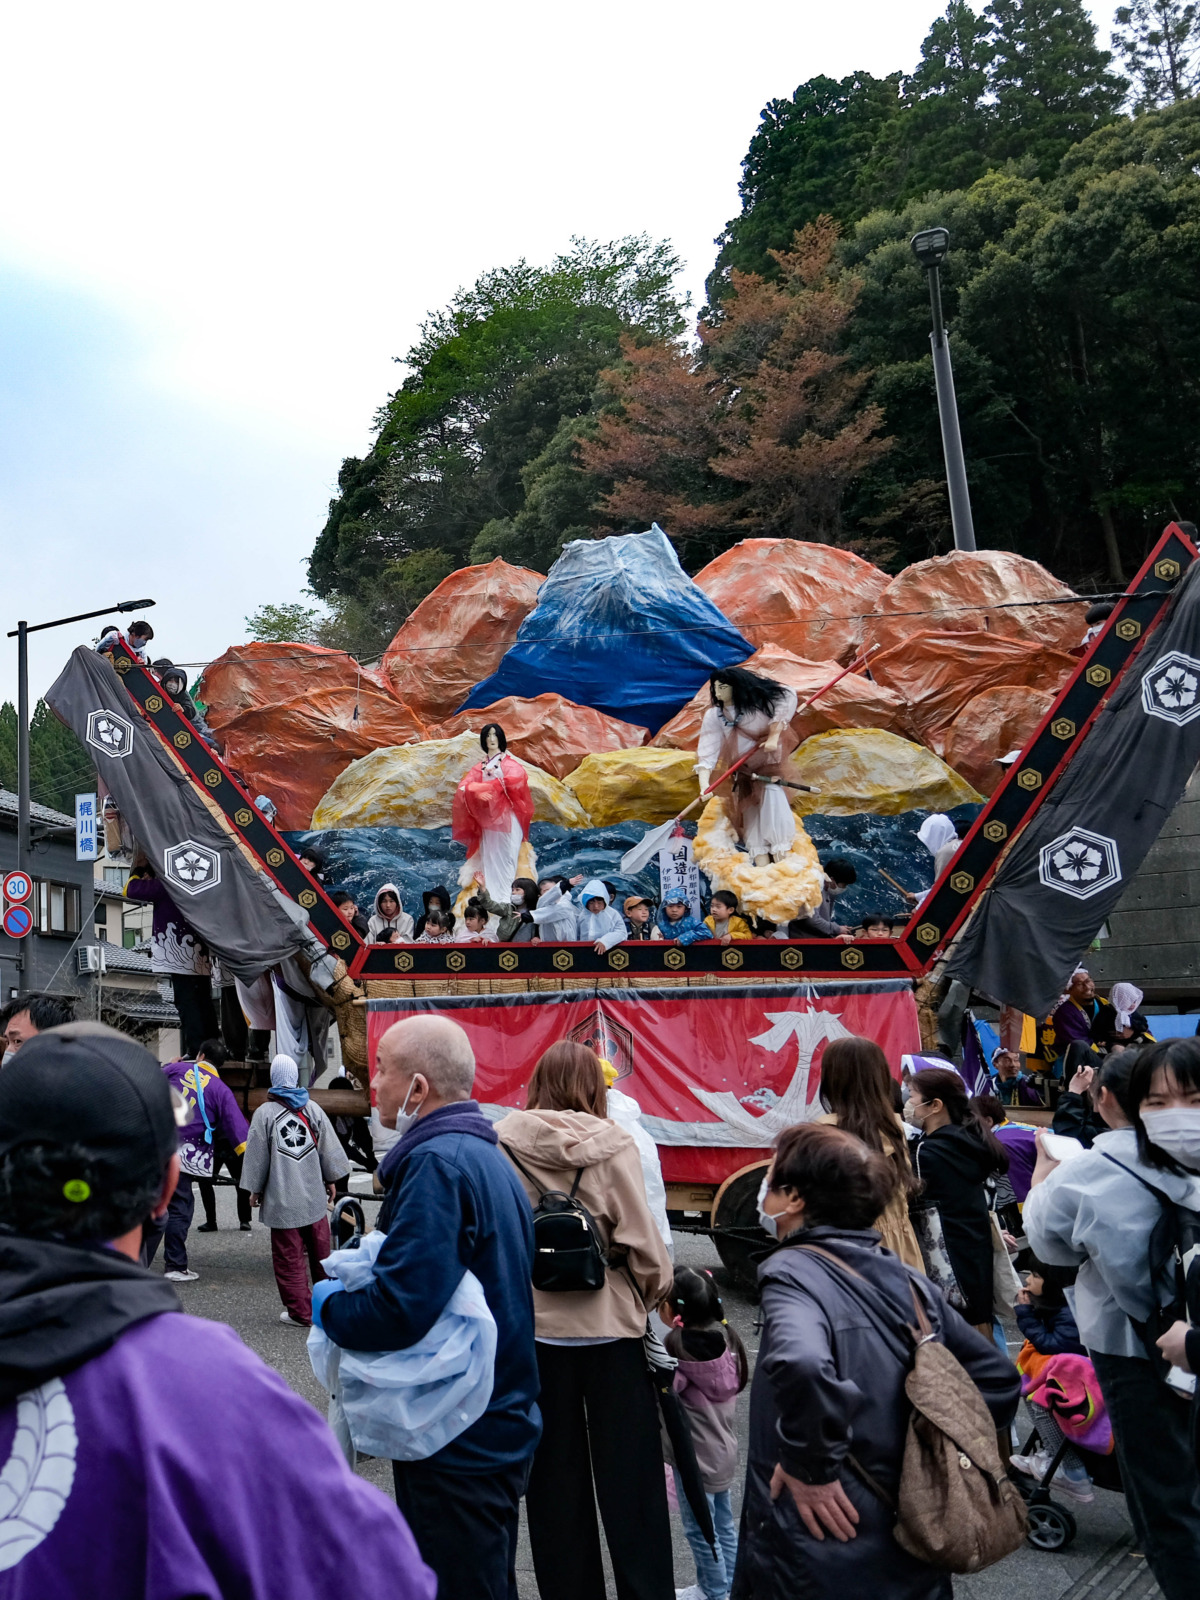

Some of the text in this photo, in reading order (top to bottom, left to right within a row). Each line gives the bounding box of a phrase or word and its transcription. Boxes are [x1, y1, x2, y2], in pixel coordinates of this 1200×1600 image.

[79, 801, 94, 853] 梶川橋
[9, 880, 26, 895] 30
